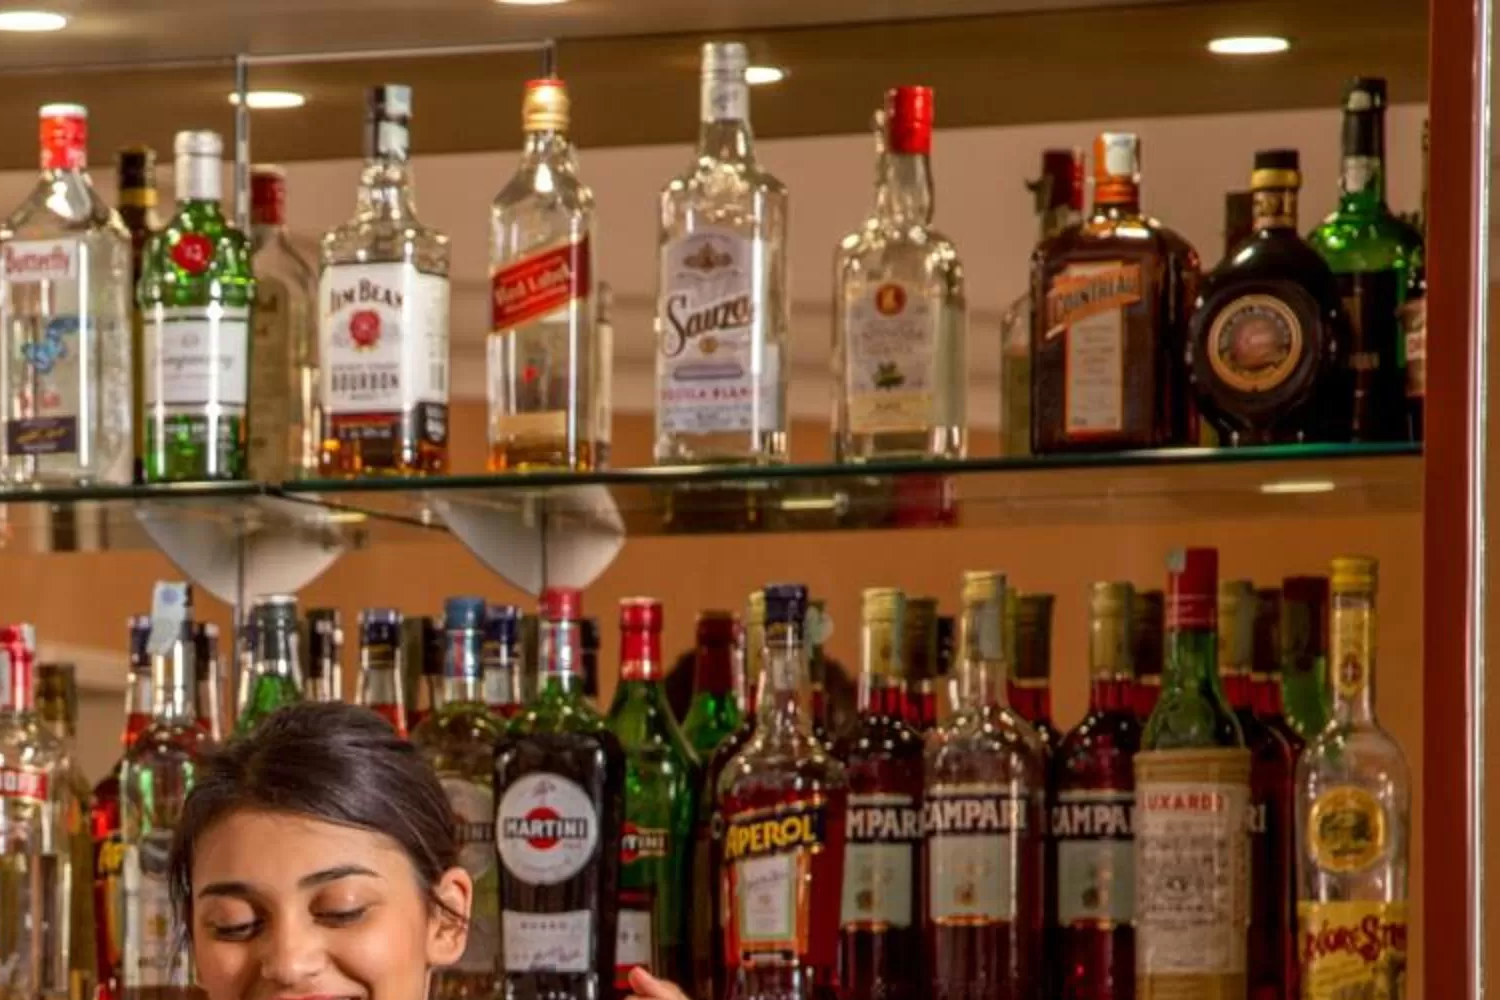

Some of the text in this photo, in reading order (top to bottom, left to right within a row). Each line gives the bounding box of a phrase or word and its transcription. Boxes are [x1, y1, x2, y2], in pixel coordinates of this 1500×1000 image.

[664, 294, 755, 358] Sauza
[504, 815, 588, 839] MARTINI
[726, 814, 815, 858] APEROL
[846, 807, 925, 840] MPARI
[1053, 803, 1134, 840] CAMPA
